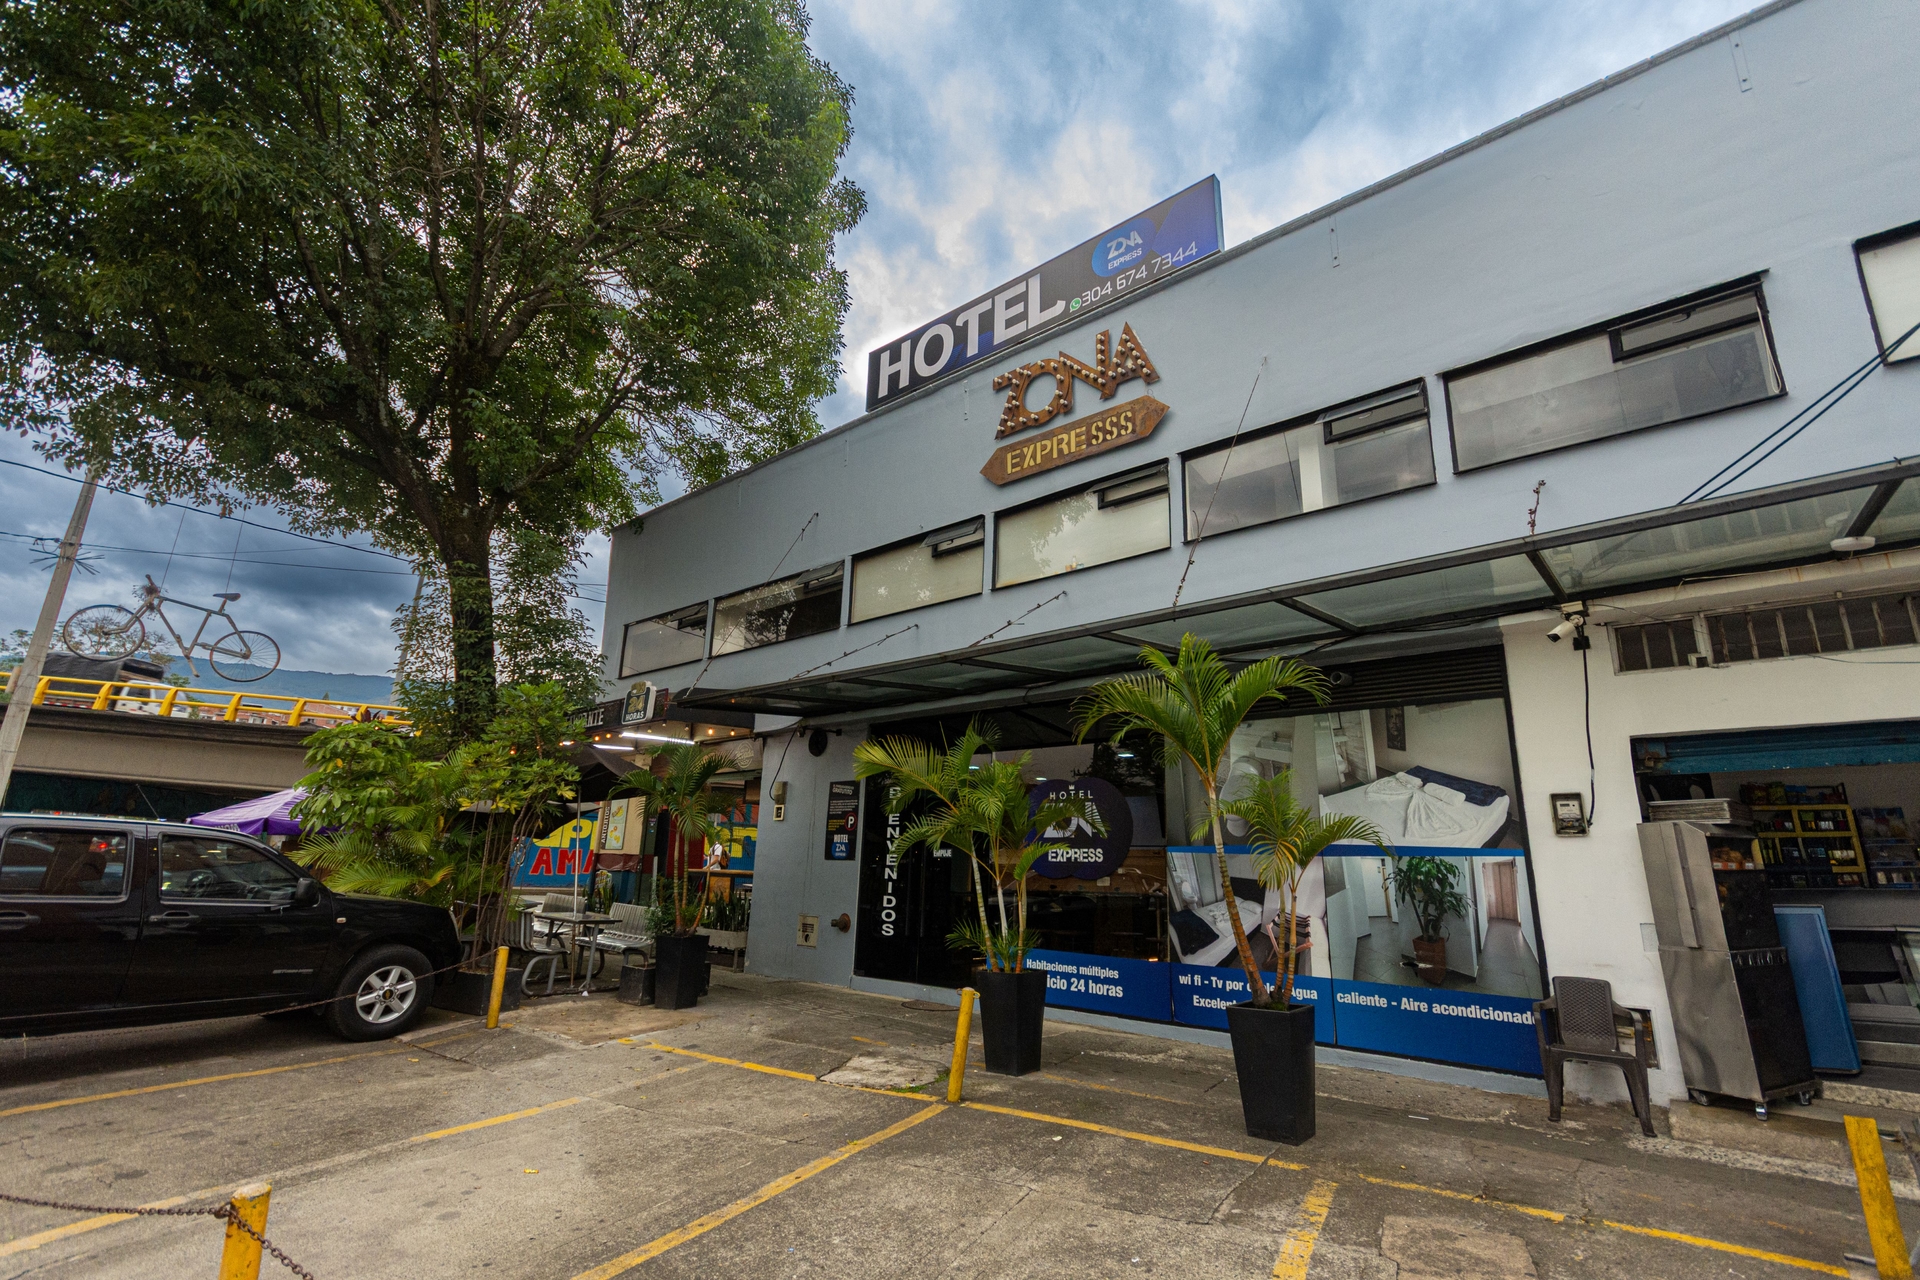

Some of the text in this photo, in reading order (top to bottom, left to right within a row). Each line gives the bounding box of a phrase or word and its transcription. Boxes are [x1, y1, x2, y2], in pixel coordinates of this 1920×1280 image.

[1107, 230, 1143, 260] ZONA
[1108, 247, 1142, 270] EXPRESS
[1082, 241, 1198, 307] 304 674 7344
[877, 273, 1067, 399] HOTEL
[992, 321, 1160, 440] ZONA
[627, 695, 645, 713] 24
[625, 711, 644, 722] HORAS
[1049, 790, 1094, 800] HOTEL
[601, 806, 611, 844] ANTOJITOS
[848, 816, 855, 828] P
[834, 834, 848, 843] HOTEL
[1048, 848, 1104, 863] EXPRESS
[1026, 958, 1119, 980] Habitaciones múltiples
[1046, 975, 1123, 998] icio 24 horas
[1179, 974, 1191, 986] wi
[1194, 975, 1201, 986] fi
[1210, 976, 1223, 989] Tv
[1226, 981, 1244, 992] por
[1336, 991, 1388, 1008] caliente
[1400, 997, 1429, 1013] Aire
[1432, 1002, 1537, 1026] acondicionad
